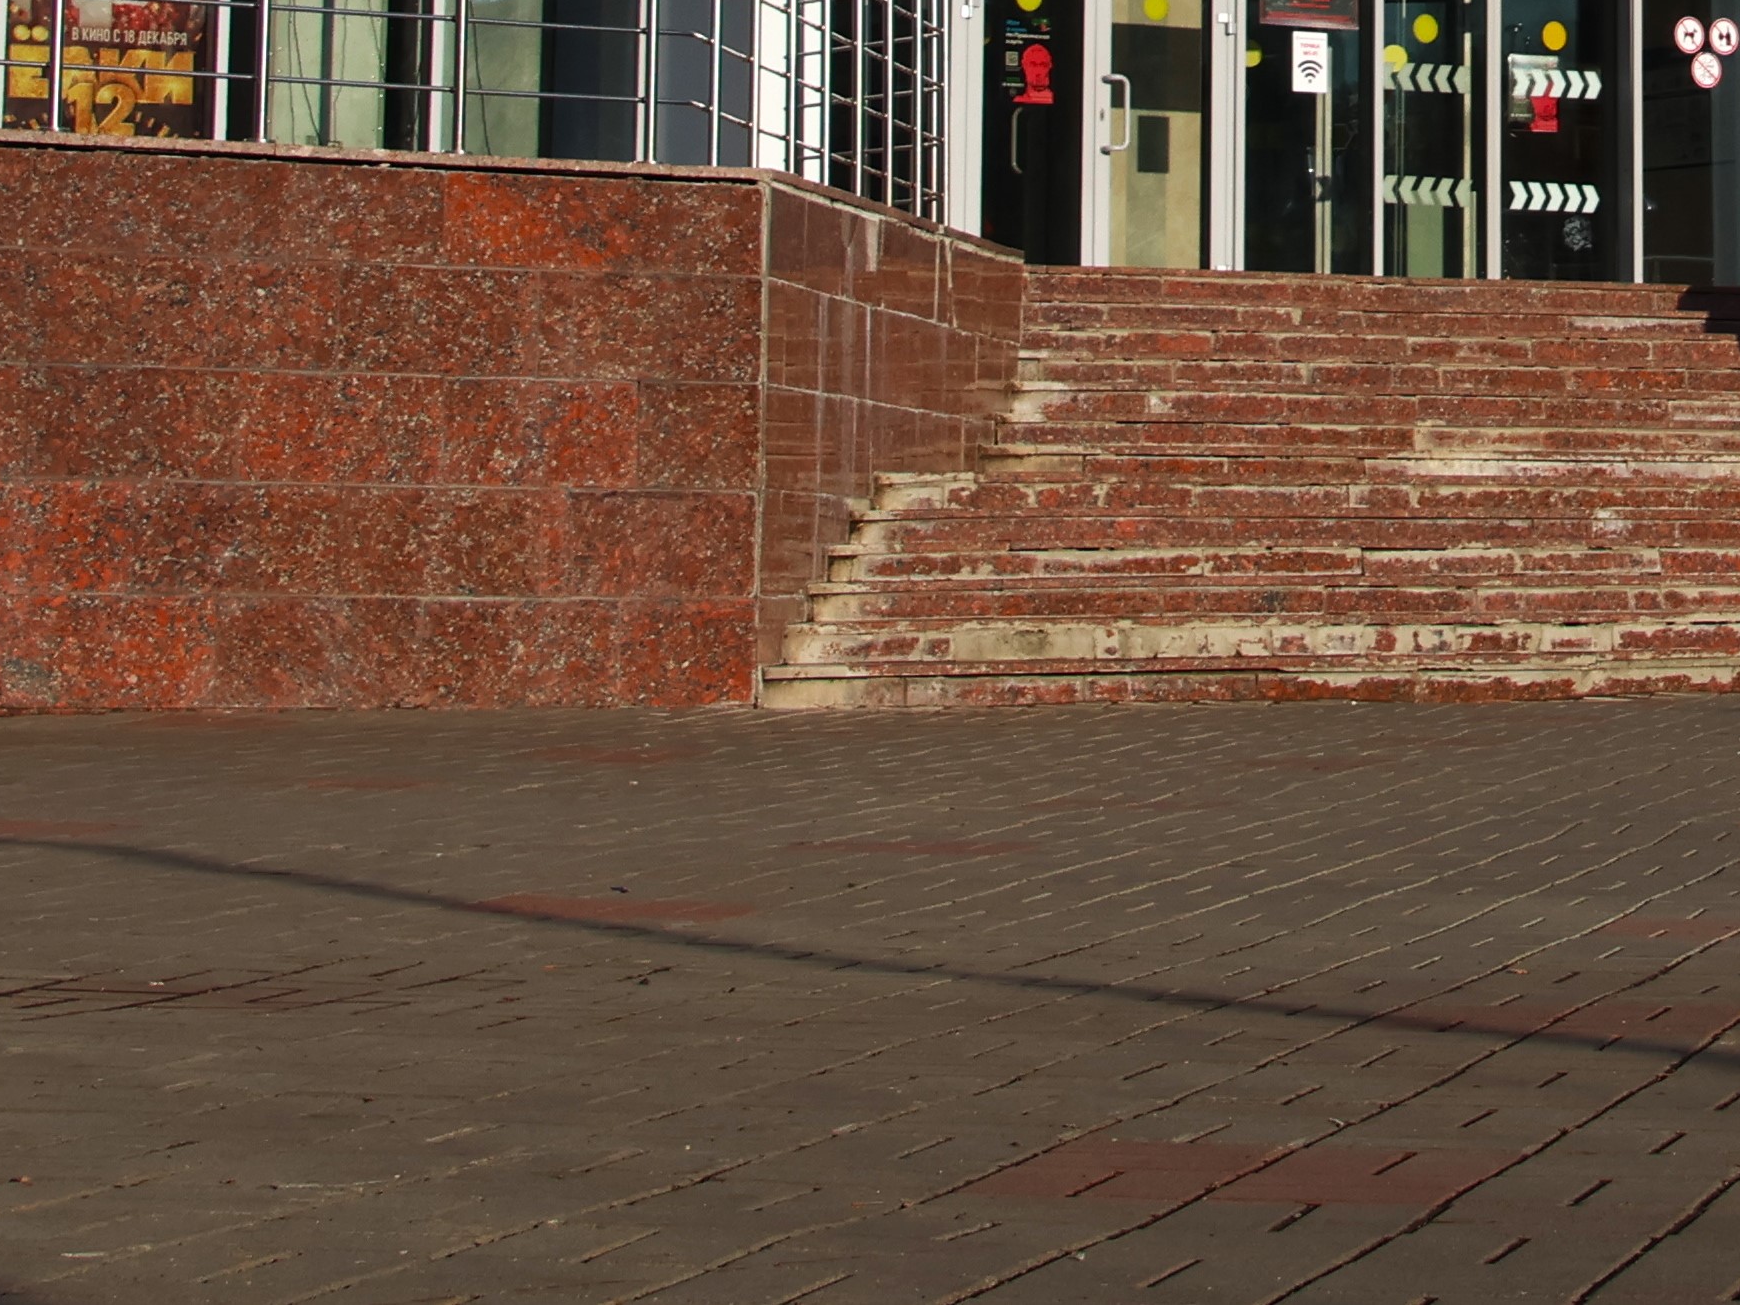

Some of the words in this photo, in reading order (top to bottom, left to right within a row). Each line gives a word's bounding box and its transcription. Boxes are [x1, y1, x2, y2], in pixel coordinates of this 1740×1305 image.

[72, 27, 79, 40] В
[82, 28, 110, 42] КИНО
[113, 30, 121, 42] С
[124, 30, 135, 43] 18
[137, 31, 188, 46] ДЕКАБРЯ
[67, 82, 136, 136] 12
